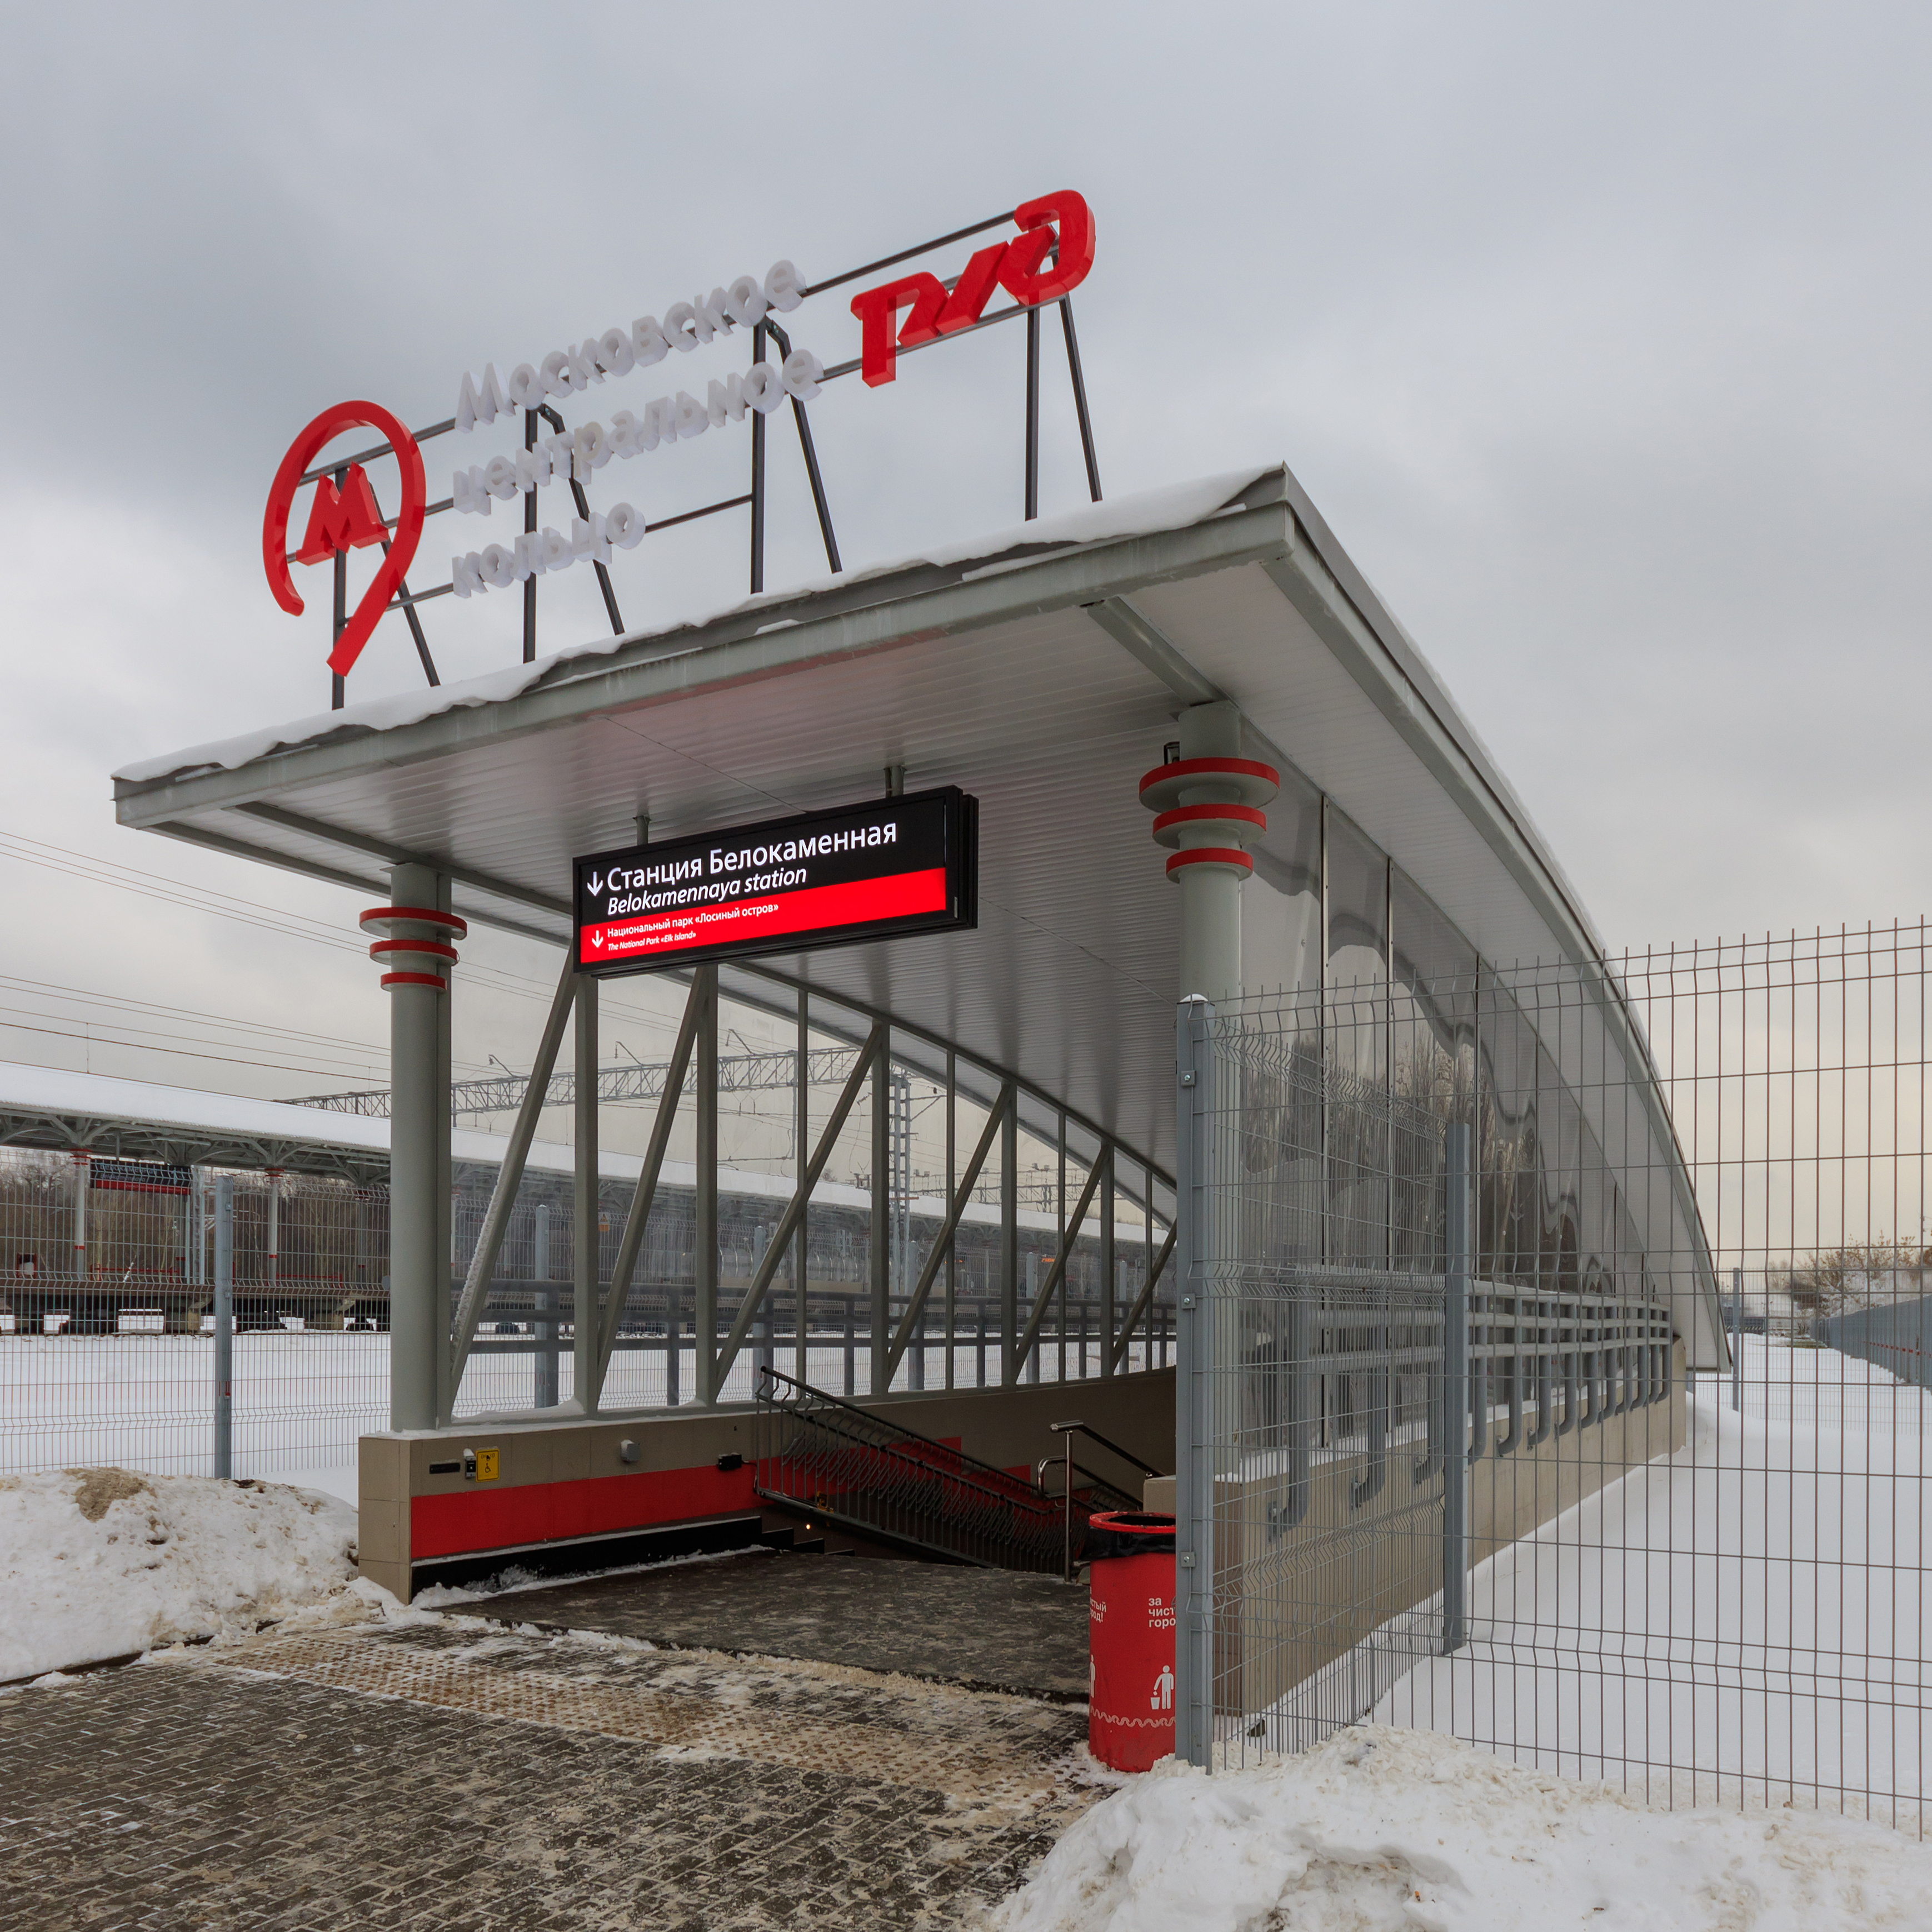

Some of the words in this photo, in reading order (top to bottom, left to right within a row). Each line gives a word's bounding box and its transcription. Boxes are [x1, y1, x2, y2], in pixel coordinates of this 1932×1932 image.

[455, 259, 807, 433] Московское
[453, 349, 824, 516] центральное
[451, 502, 646, 598] кольцо
[607, 858, 702, 891] Станция
[710, 822, 896, 874] Белокаменная
[608, 880, 741, 916] Belokamennaya
[744, 867, 807, 893] station
[607, 918, 670, 937] Национальный
[672, 917, 693, 928] парк
[695, 906, 740, 923] «Лосиный
[742, 903, 778, 917] остров»
[620, 937, 646, 949] National
[646, 936, 660, 945] Park
[1148, 1597, 1162, 1606] за
[1148, 1607, 1176, 1617] чист
[1148, 1617, 1176, 1630] горо
